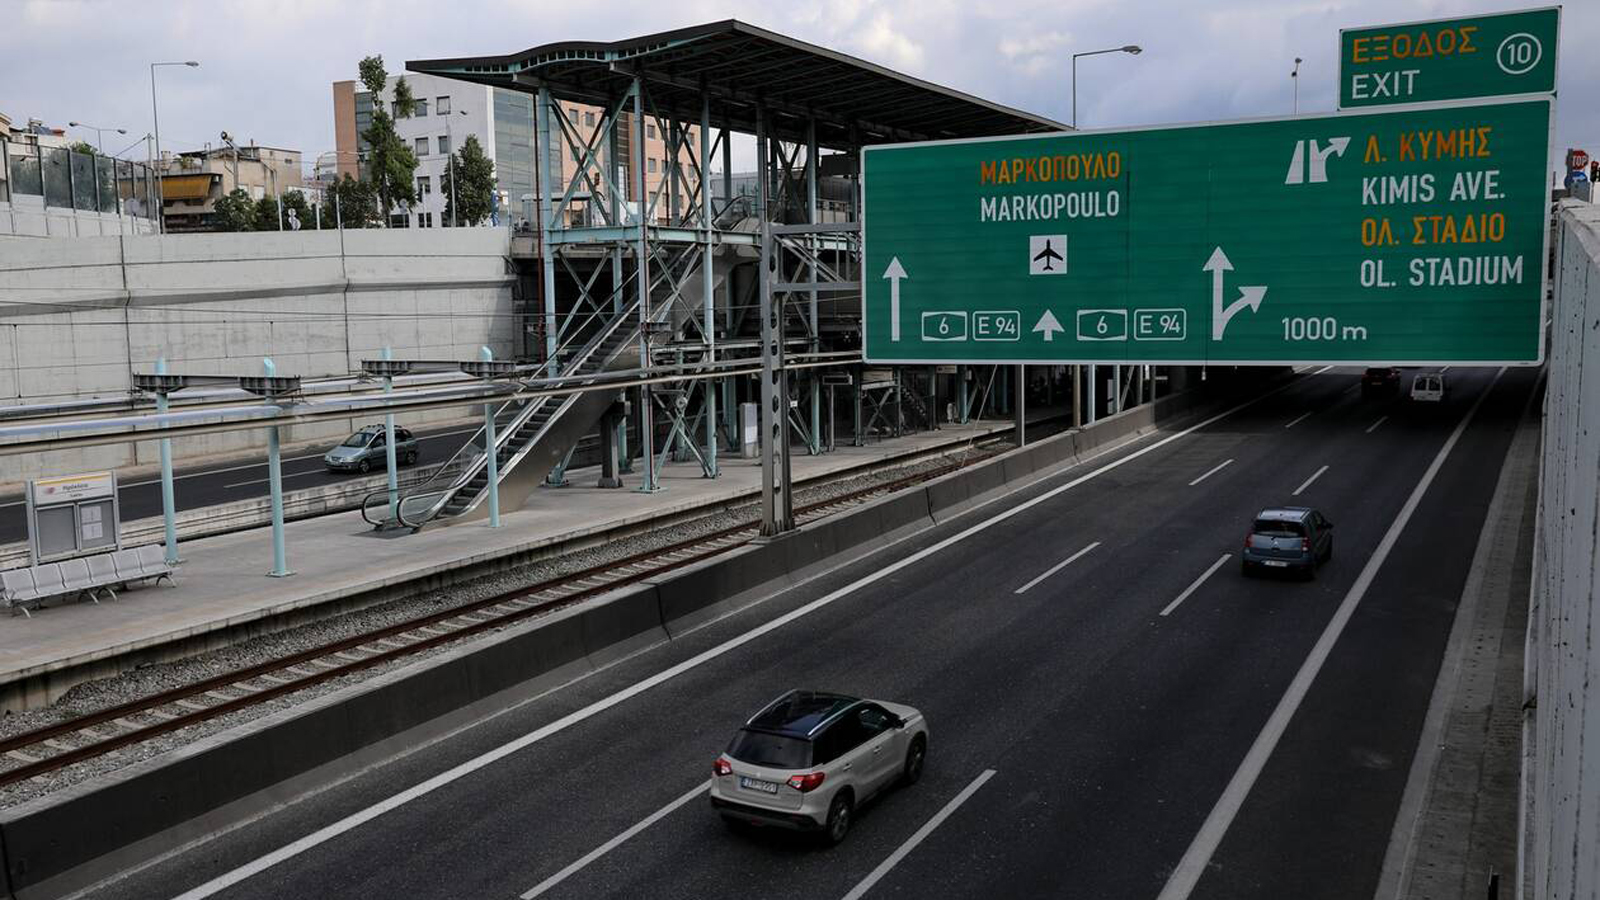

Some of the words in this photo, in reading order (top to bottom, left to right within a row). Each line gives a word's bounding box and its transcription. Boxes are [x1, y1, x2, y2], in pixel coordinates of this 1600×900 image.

[1353, 26, 1478, 63] ΕΞΟΔΟΣ
[1507, 42, 1531, 65] 10
[1352, 70, 1420, 99] EXIT
[1364, 135, 1387, 163] Λ.
[1400, 126, 1492, 162] ΚΥΜΗΣ
[981, 152, 1120, 185] ΜΑΡΚΟΠΟΥΛΟ
[1362, 174, 1435, 205] KIMIS
[1450, 170, 1505, 201] AVE.
[981, 190, 1120, 222] MARKOPOULO
[1361, 218, 1400, 246] ΟΛ.
[1412, 213, 1505, 244] ΣΤΑΔΙΟ
[1360, 259, 1397, 287] OL.
[1409, 255, 1523, 286] STADIUM
[939, 317, 949, 335] 6
[978, 316, 990, 334] E
[996, 316, 1016, 335] 94
[1097, 315, 1108, 334] 6
[1140, 315, 1153, 334] E
[1160, 314, 1181, 333] 94
[1282, 317, 1337, 341] 1000
[1342, 326, 1367, 340] m
